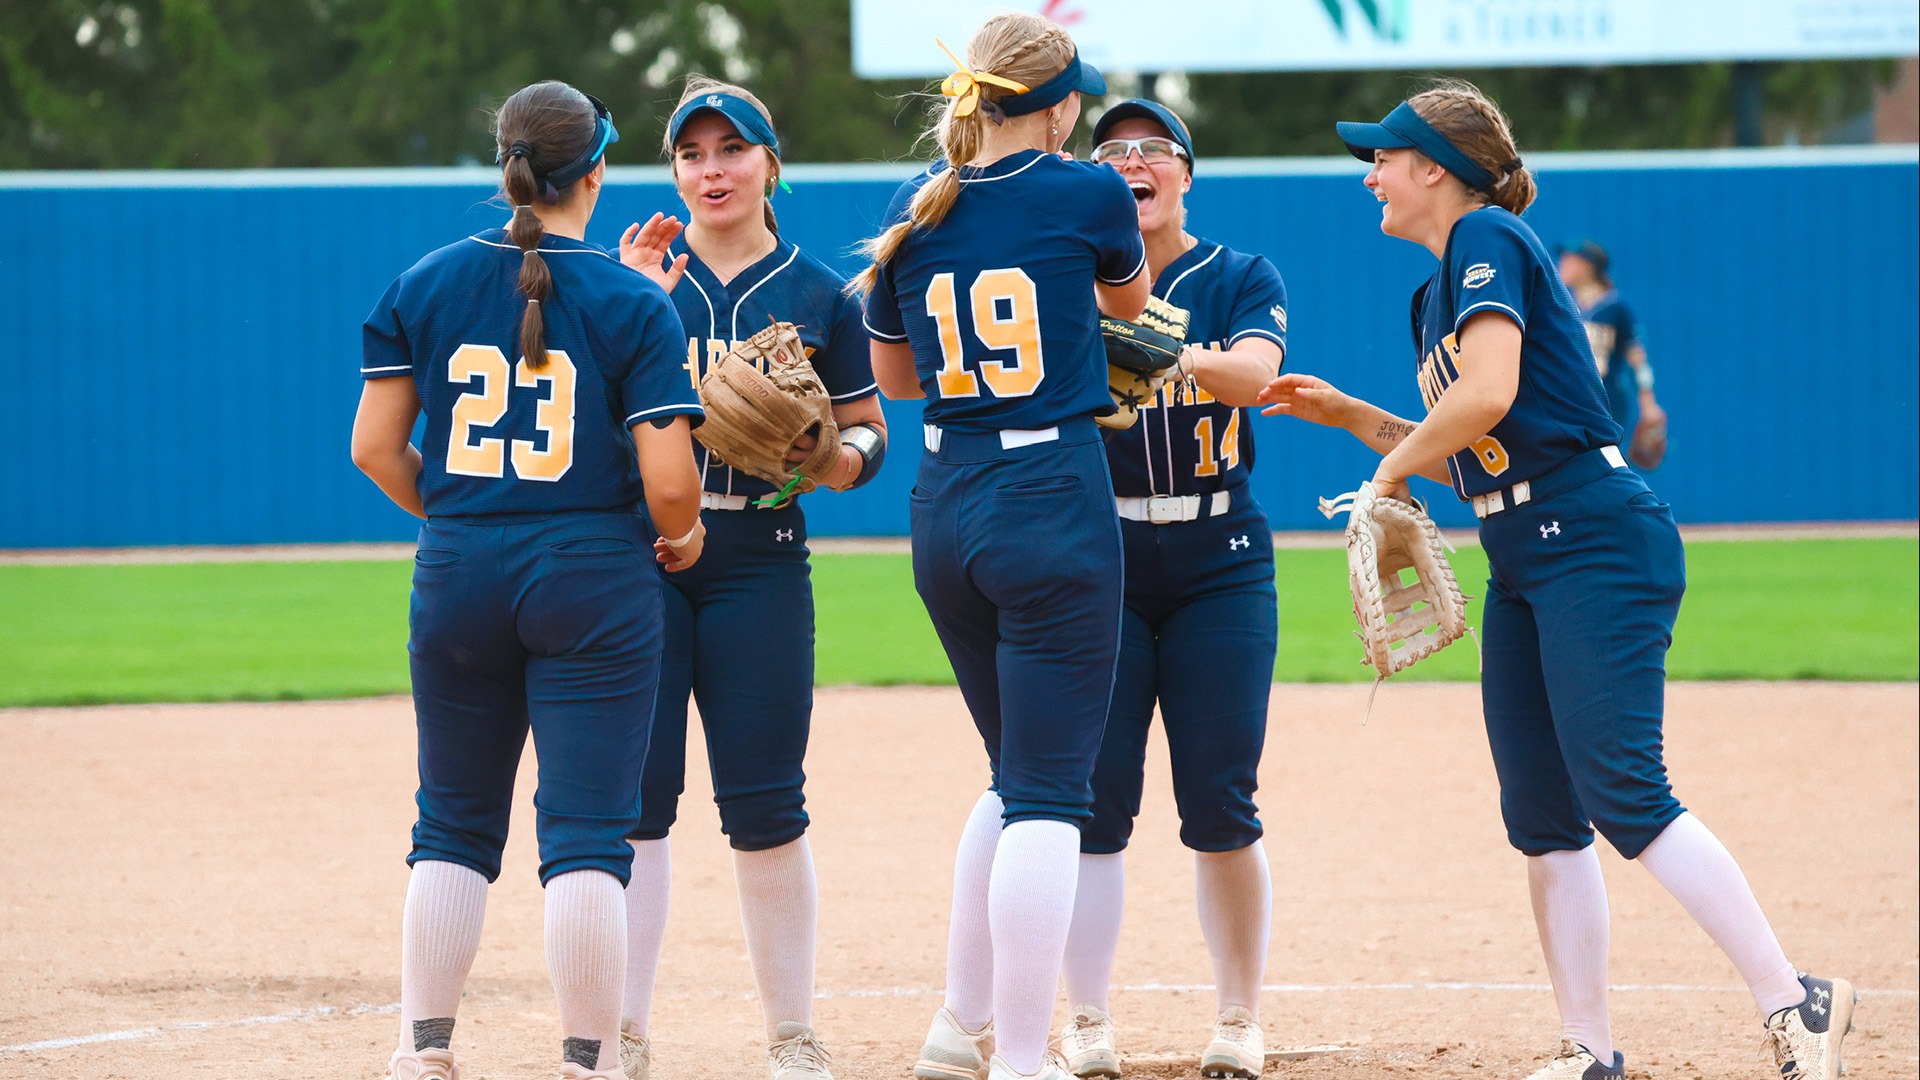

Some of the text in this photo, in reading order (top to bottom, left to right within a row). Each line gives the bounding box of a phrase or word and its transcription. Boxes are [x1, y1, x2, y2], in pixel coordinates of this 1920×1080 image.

[925, 267, 1045, 399] 19
[1100, 320, 1135, 336] Patton
[446, 343, 577, 482] 23
[1194, 407, 1240, 477] 14
[1469, 434, 1510, 478] 6
